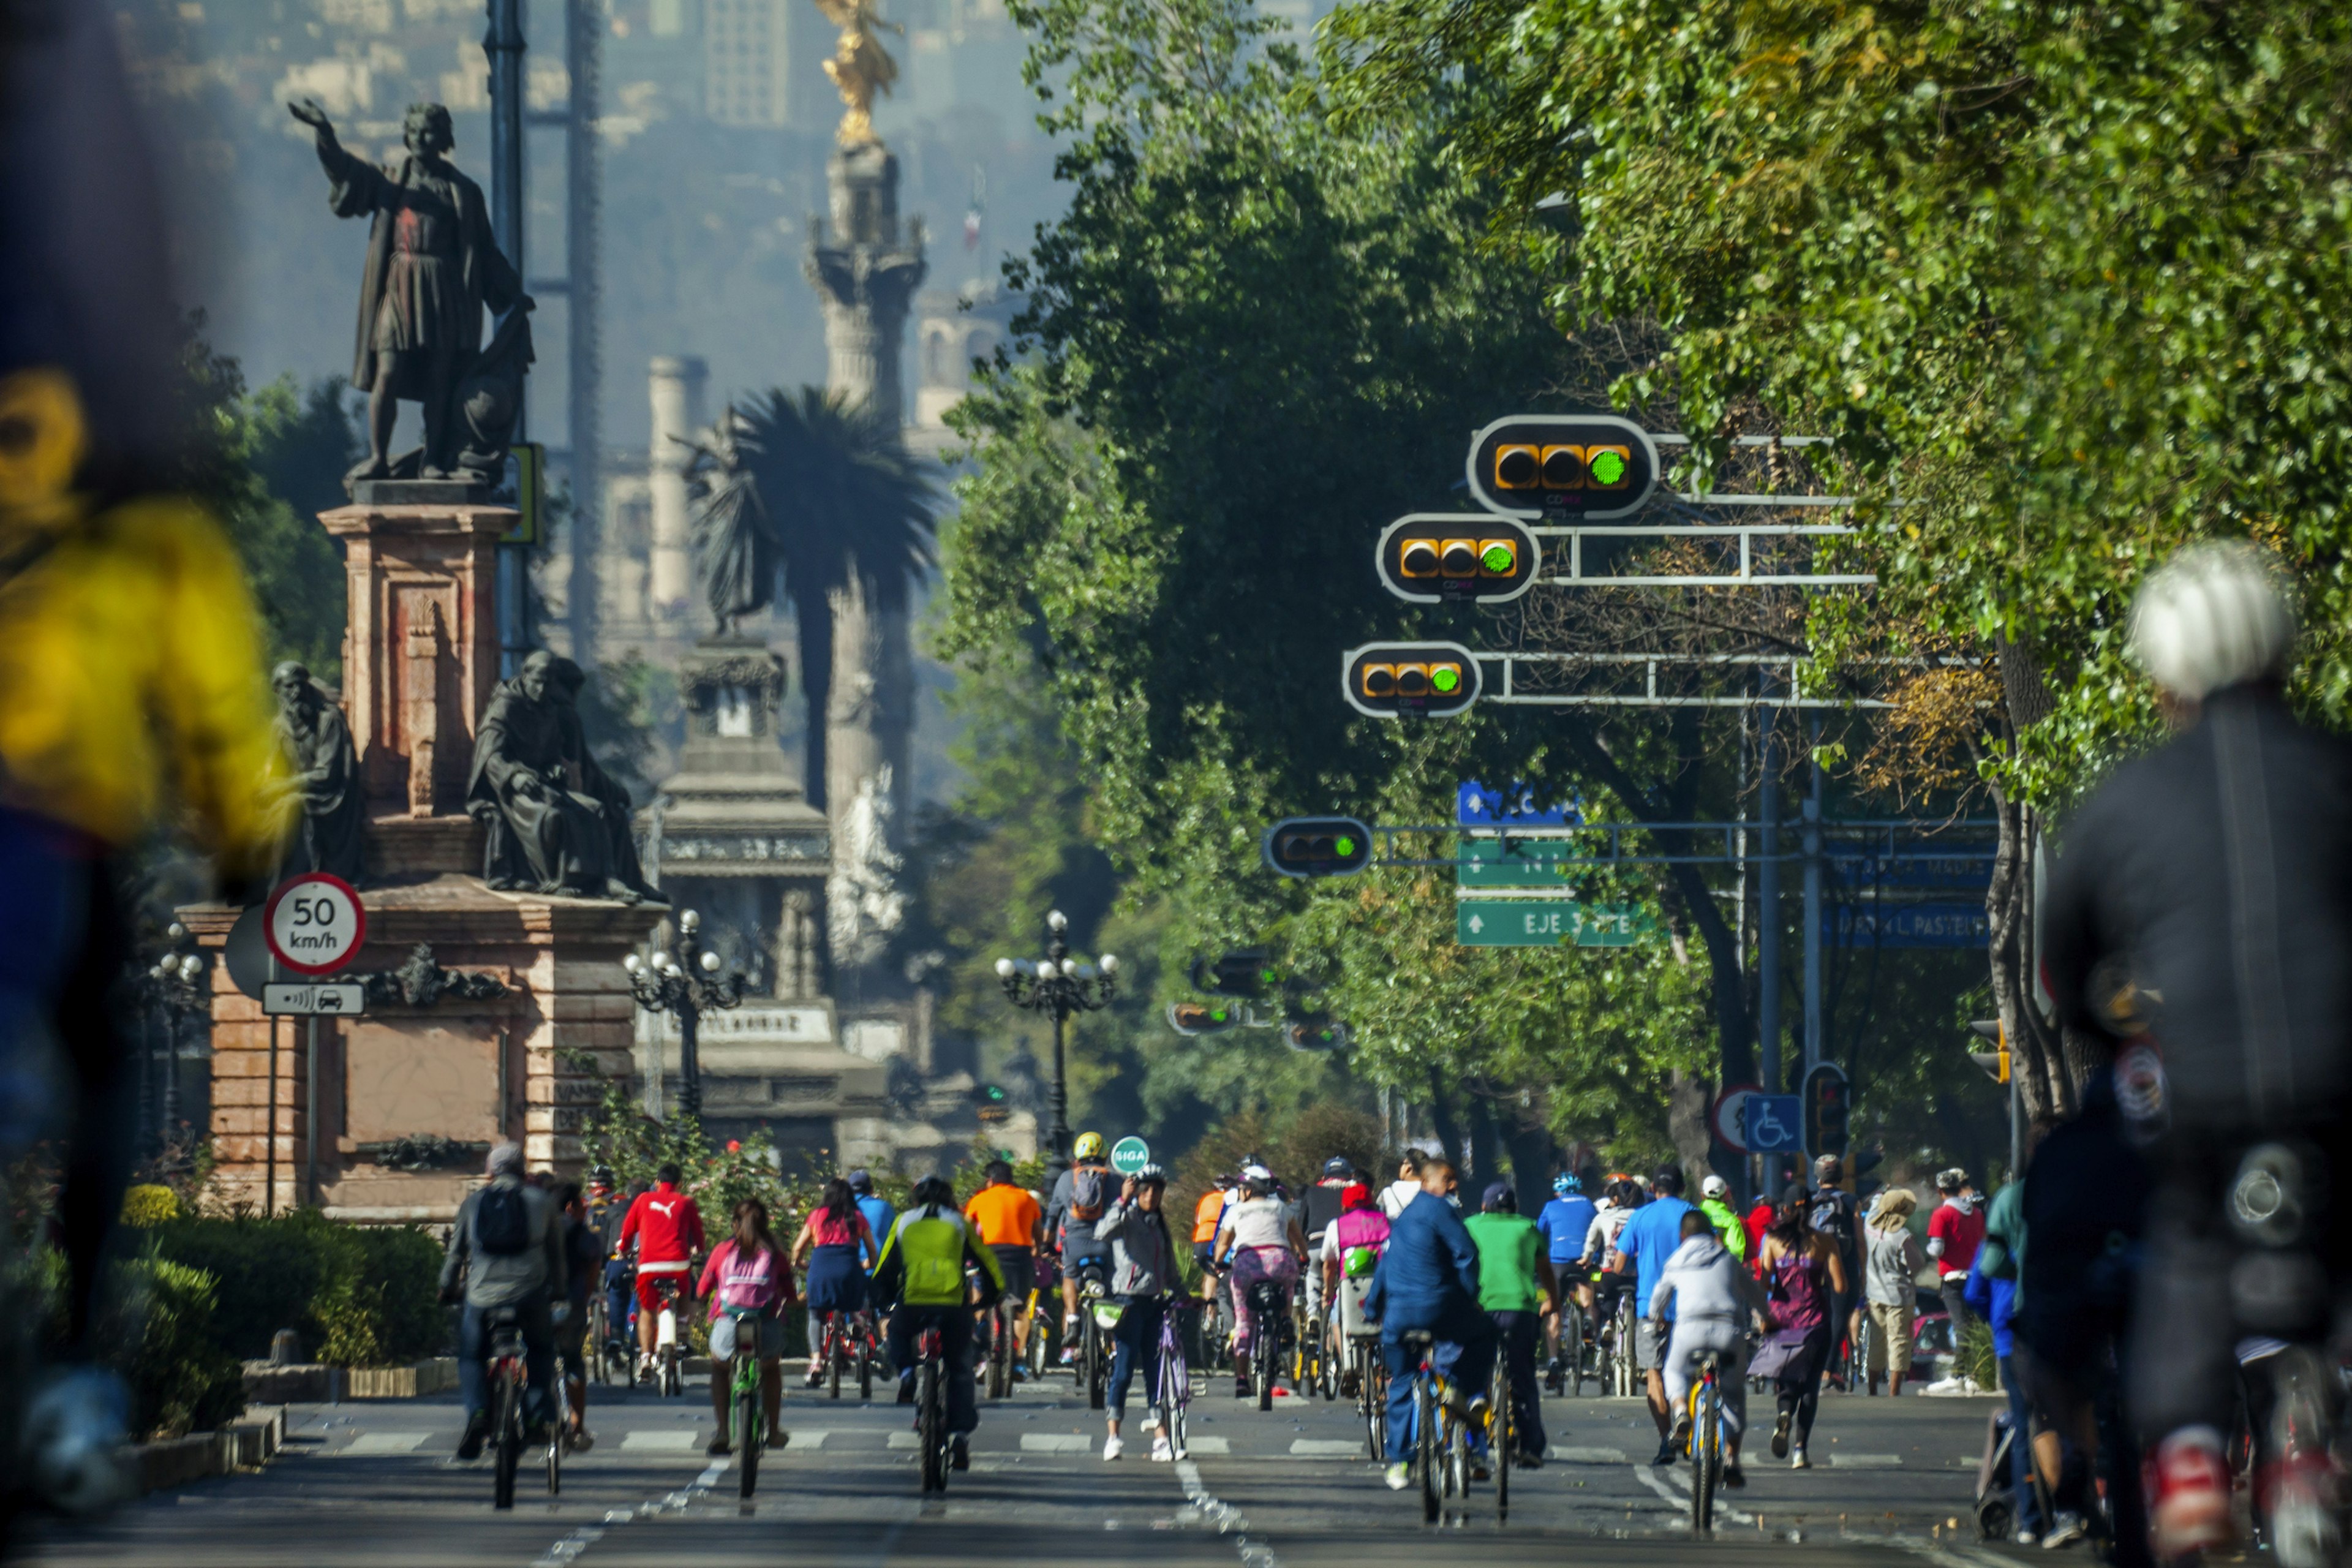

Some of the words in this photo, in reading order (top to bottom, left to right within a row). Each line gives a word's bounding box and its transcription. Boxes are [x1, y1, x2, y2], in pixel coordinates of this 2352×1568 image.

[293, 898, 336, 926] 50
[1525, 914, 1561, 934] EJE
[1572, 911, 1582, 934] 3
[290, 932, 337, 948] km/h
[1115, 1150, 1145, 1161] SIGA
